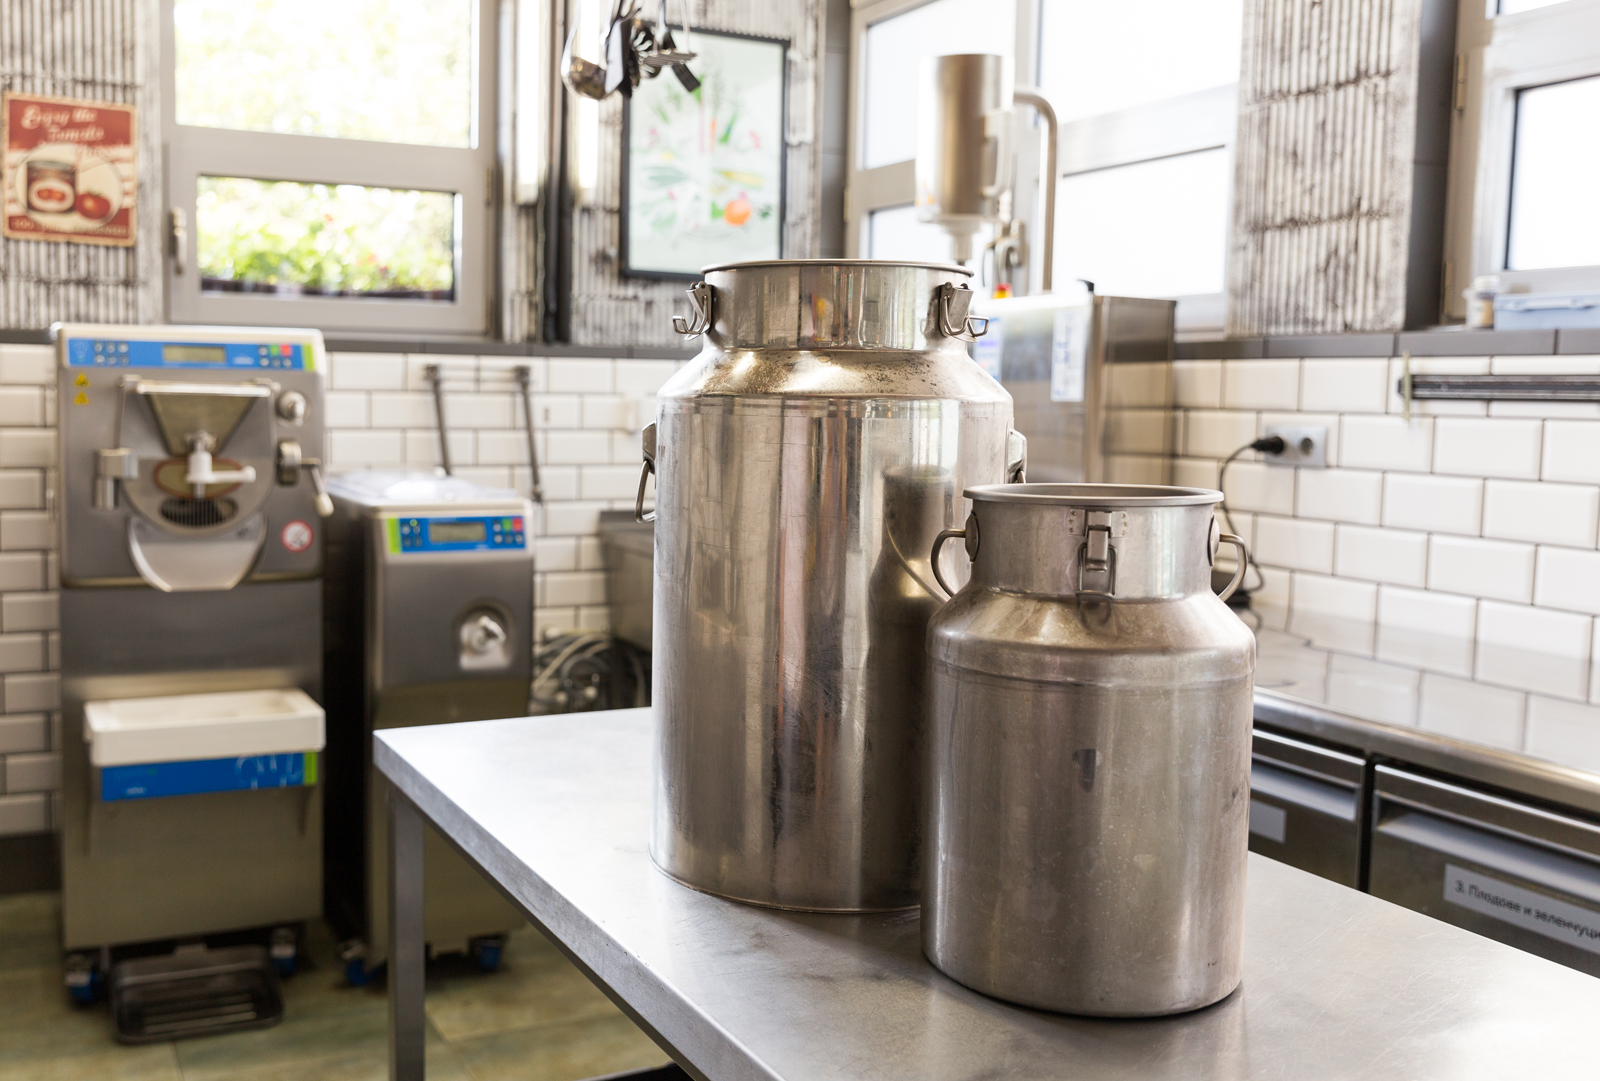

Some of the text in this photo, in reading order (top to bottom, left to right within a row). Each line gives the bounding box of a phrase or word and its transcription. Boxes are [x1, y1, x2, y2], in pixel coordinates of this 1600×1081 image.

[1455, 880, 1466, 894] 3.
[1468, 884, 1522, 913] Плодове
[1523, 905, 1533, 917] и
